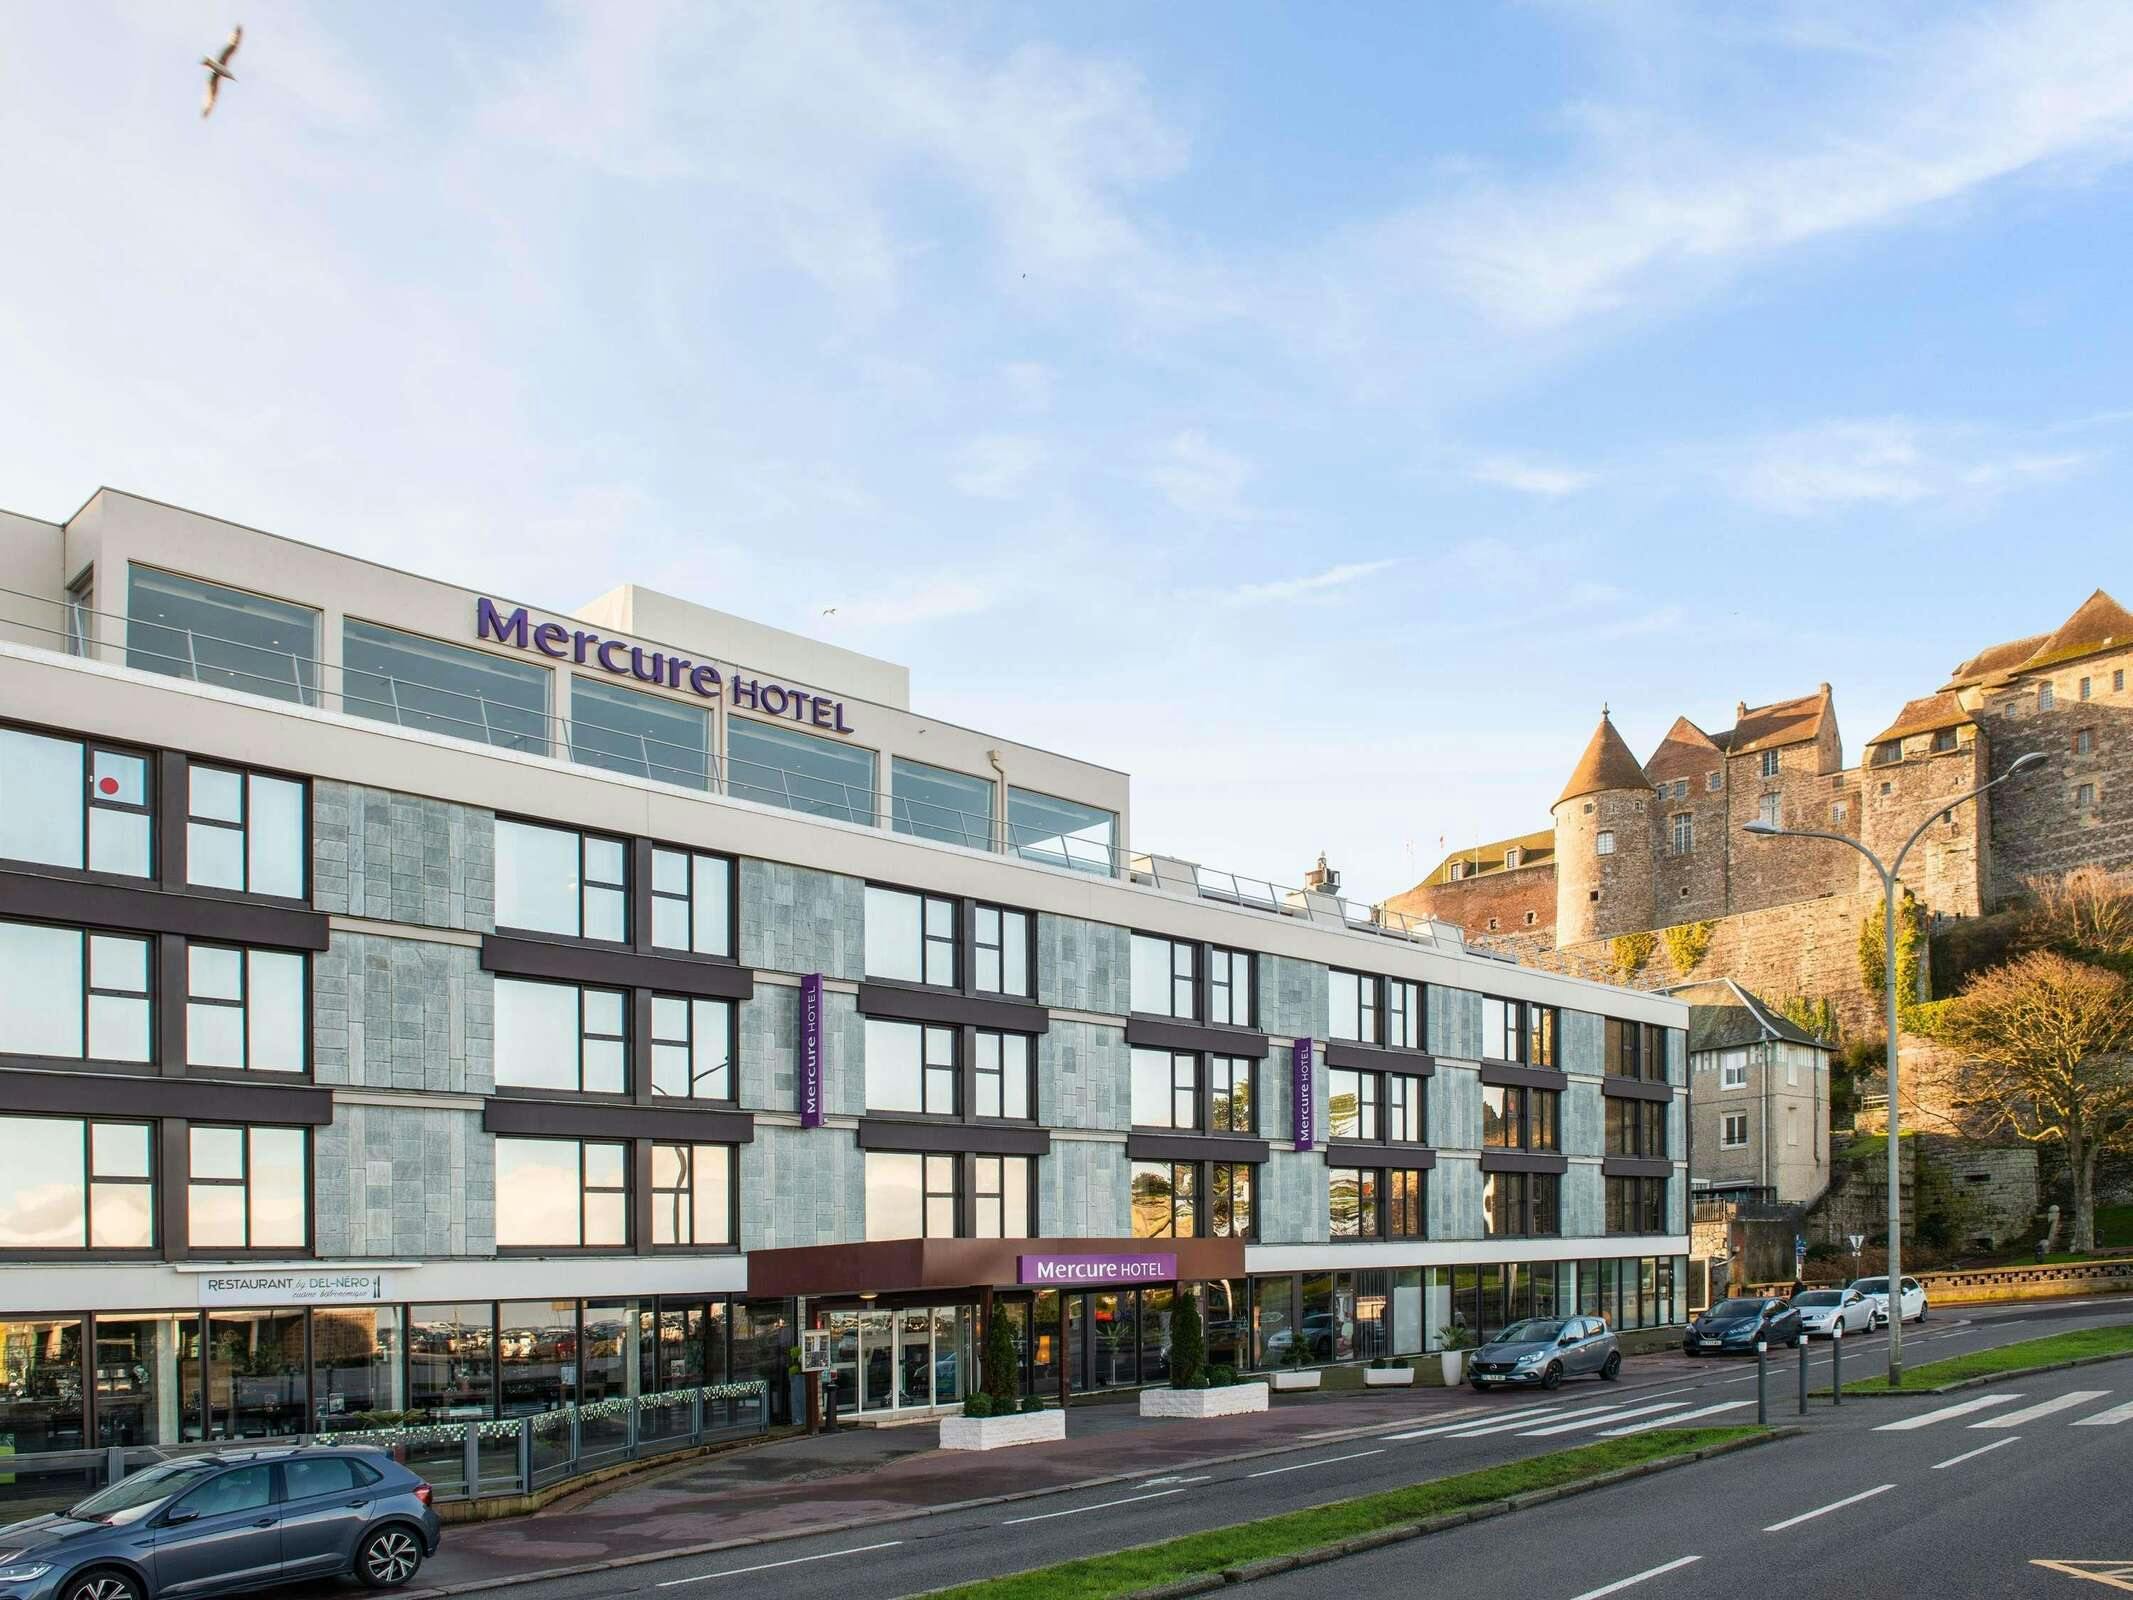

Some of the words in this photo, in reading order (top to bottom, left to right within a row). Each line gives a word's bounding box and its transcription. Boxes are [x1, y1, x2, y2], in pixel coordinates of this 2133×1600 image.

[478, 597, 721, 698] Mercure
[733, 675, 854, 735] HOTEL
[808, 985, 816, 1032] HOTEL
[807, 1036, 816, 1114] Mercure
[1301, 1046, 1309, 1080] HOTEL
[1301, 1083, 1309, 1141] Mercure
[208, 1278, 293, 1291] RESTAURANT
[1037, 1261, 1117, 1278] Mercure
[1121, 1262, 1165, 1276] HOTEL
